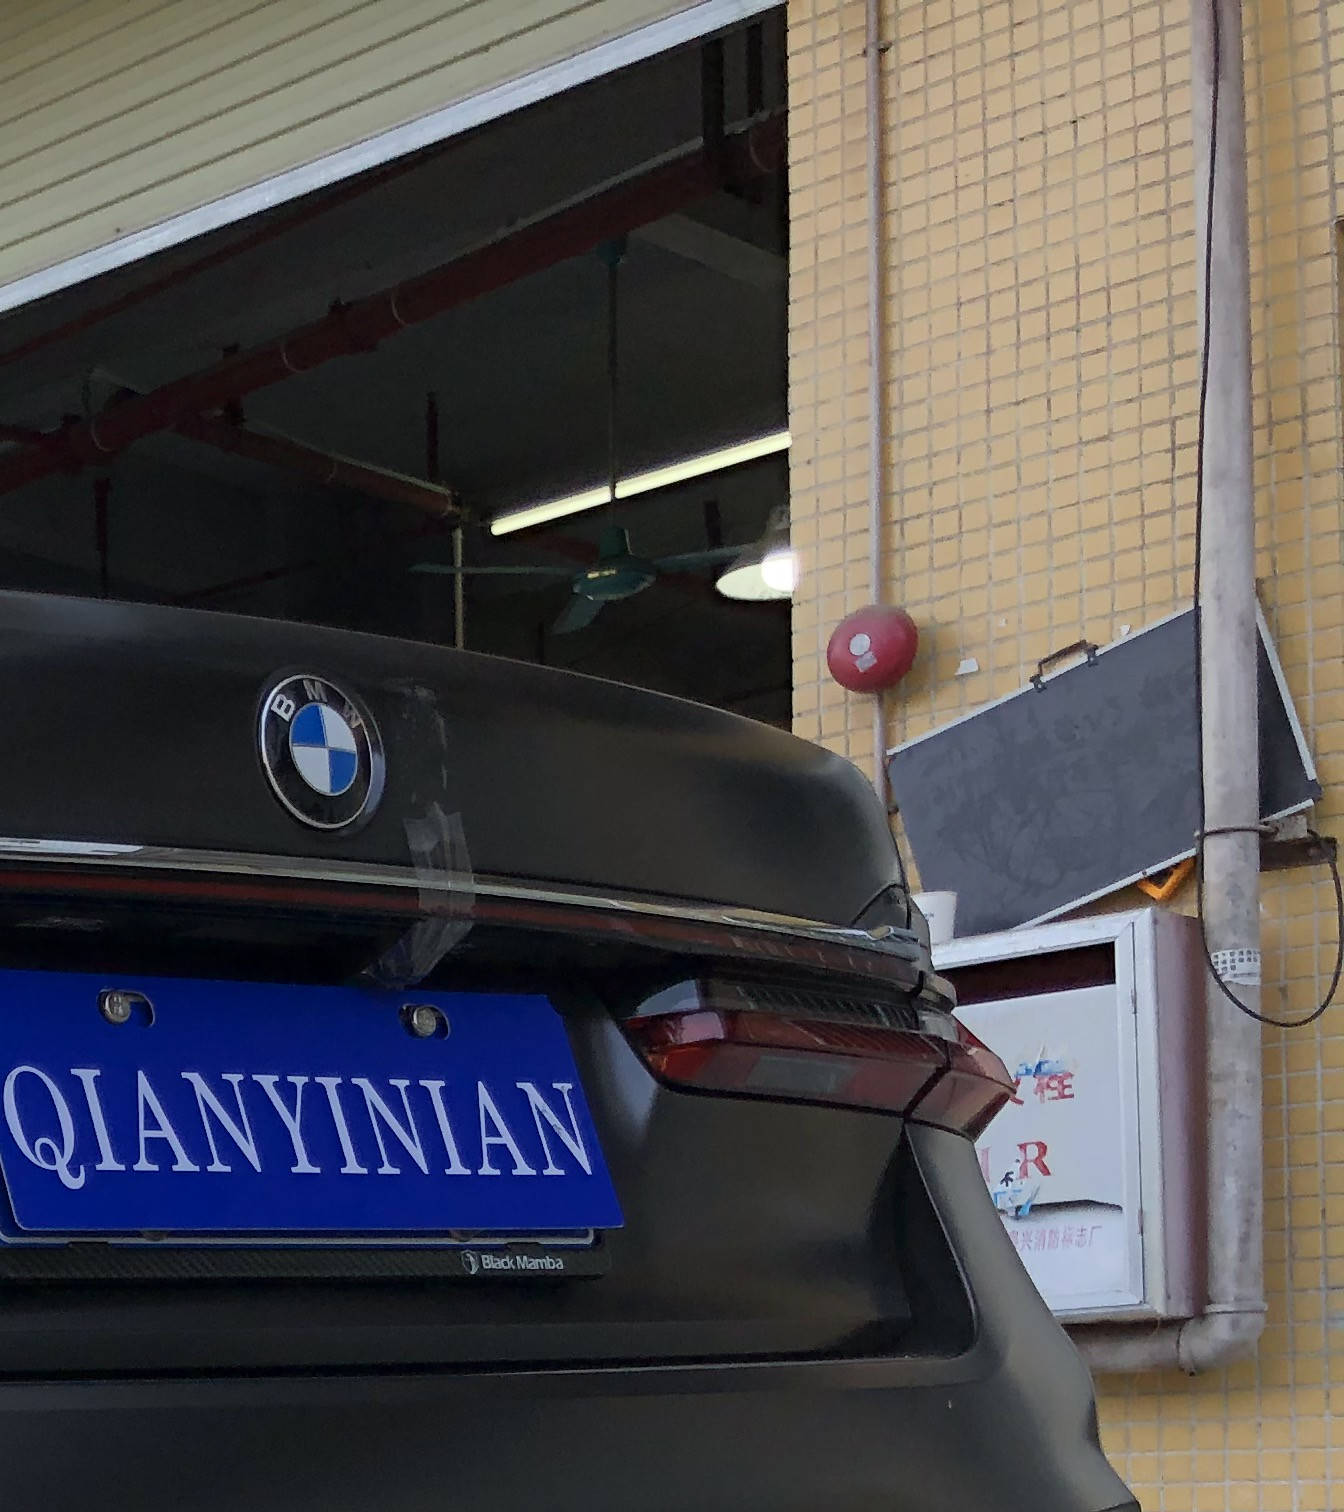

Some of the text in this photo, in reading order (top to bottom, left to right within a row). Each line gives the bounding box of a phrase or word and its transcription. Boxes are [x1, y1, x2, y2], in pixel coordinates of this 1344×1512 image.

[271, 679, 362, 729] BMW
[3, 1065, 593, 1190] QIANYINIAN
[480, 1254, 564, 1270] Black Mamba
